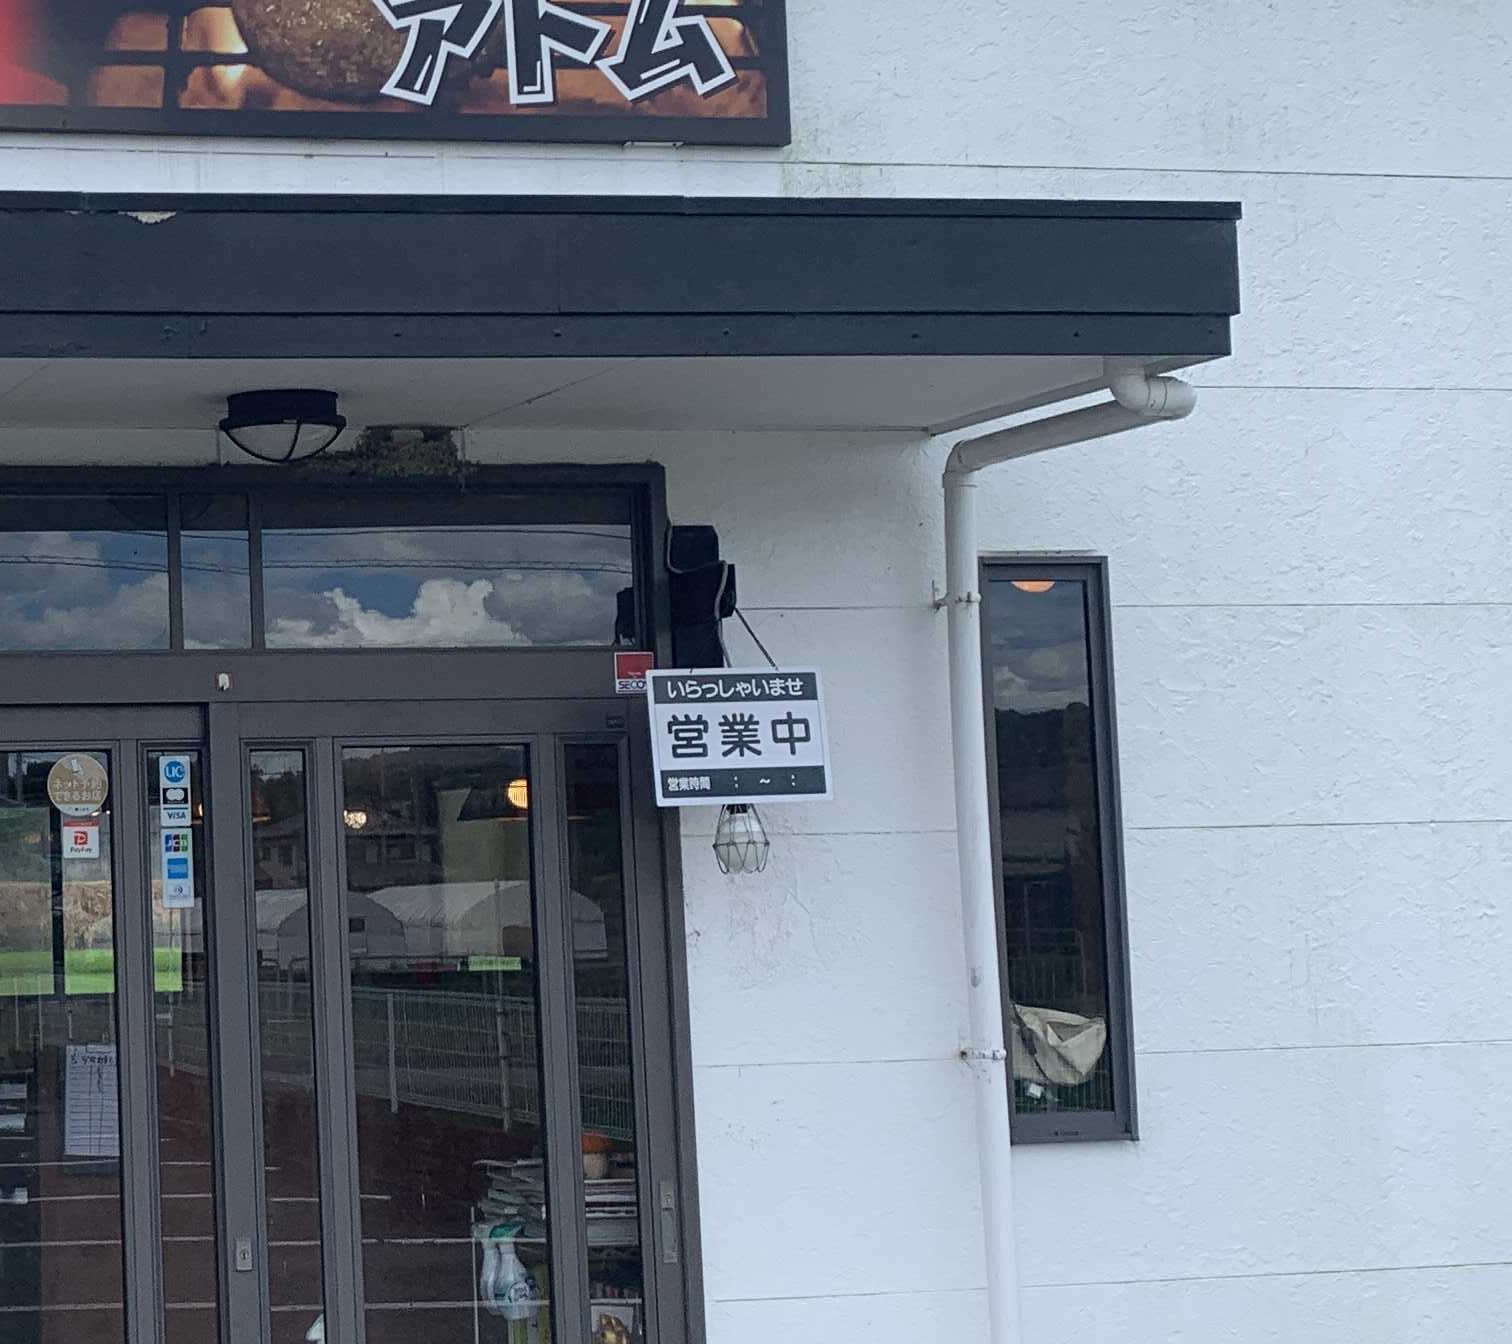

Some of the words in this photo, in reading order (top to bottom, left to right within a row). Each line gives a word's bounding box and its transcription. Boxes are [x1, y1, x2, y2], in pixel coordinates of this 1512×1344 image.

[618, 679, 647, 690] SECO
[667, 678, 804, 699] いらっしゃいませ
[667, 711, 812, 759] 営業中
[667, 776, 711, 791] 営業時間
[167, 811, 186, 819] VISA
